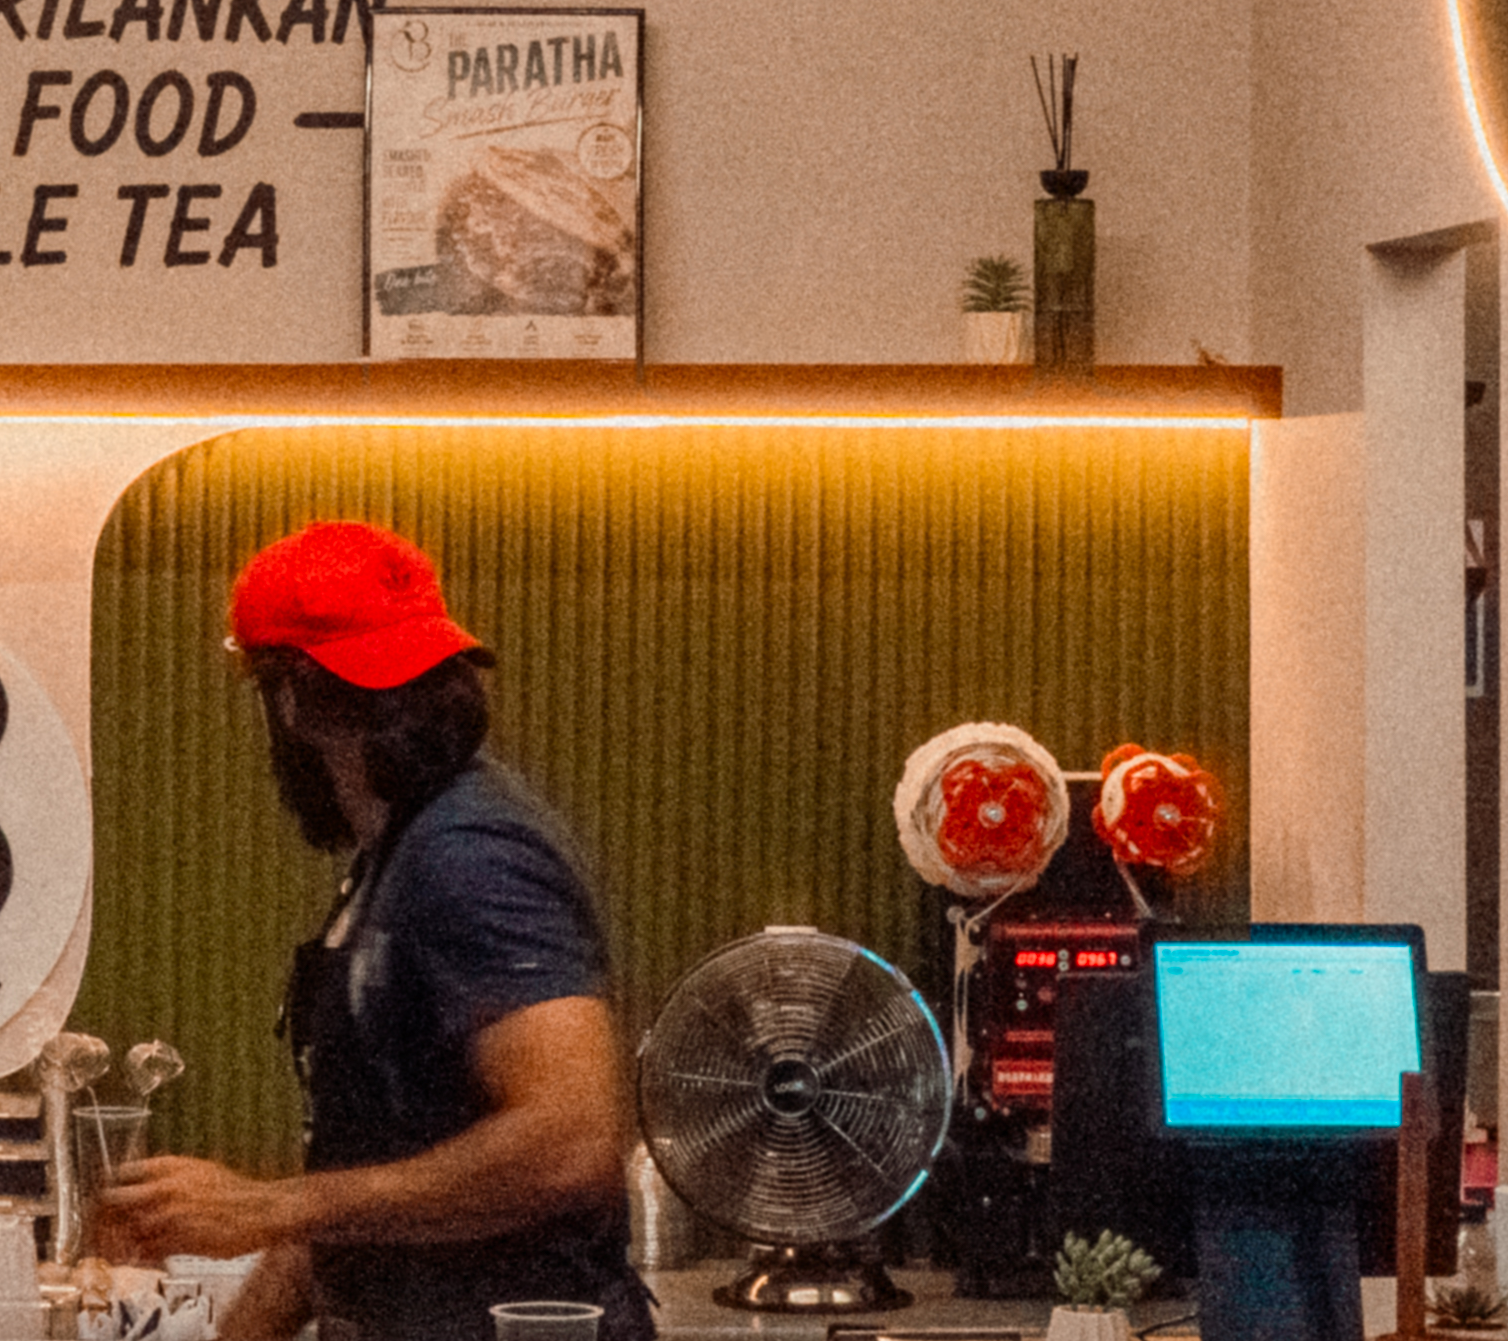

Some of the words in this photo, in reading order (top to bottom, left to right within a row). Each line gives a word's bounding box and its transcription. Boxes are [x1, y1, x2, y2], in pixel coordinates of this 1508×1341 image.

[448, 31, 624, 100] PARATHA
[14, 70, 257, 157] FOOD
[420, 89, 514, 139] Smash
[525, 87, 621, 121] Burger
[117, 183, 280, 267] TEA
